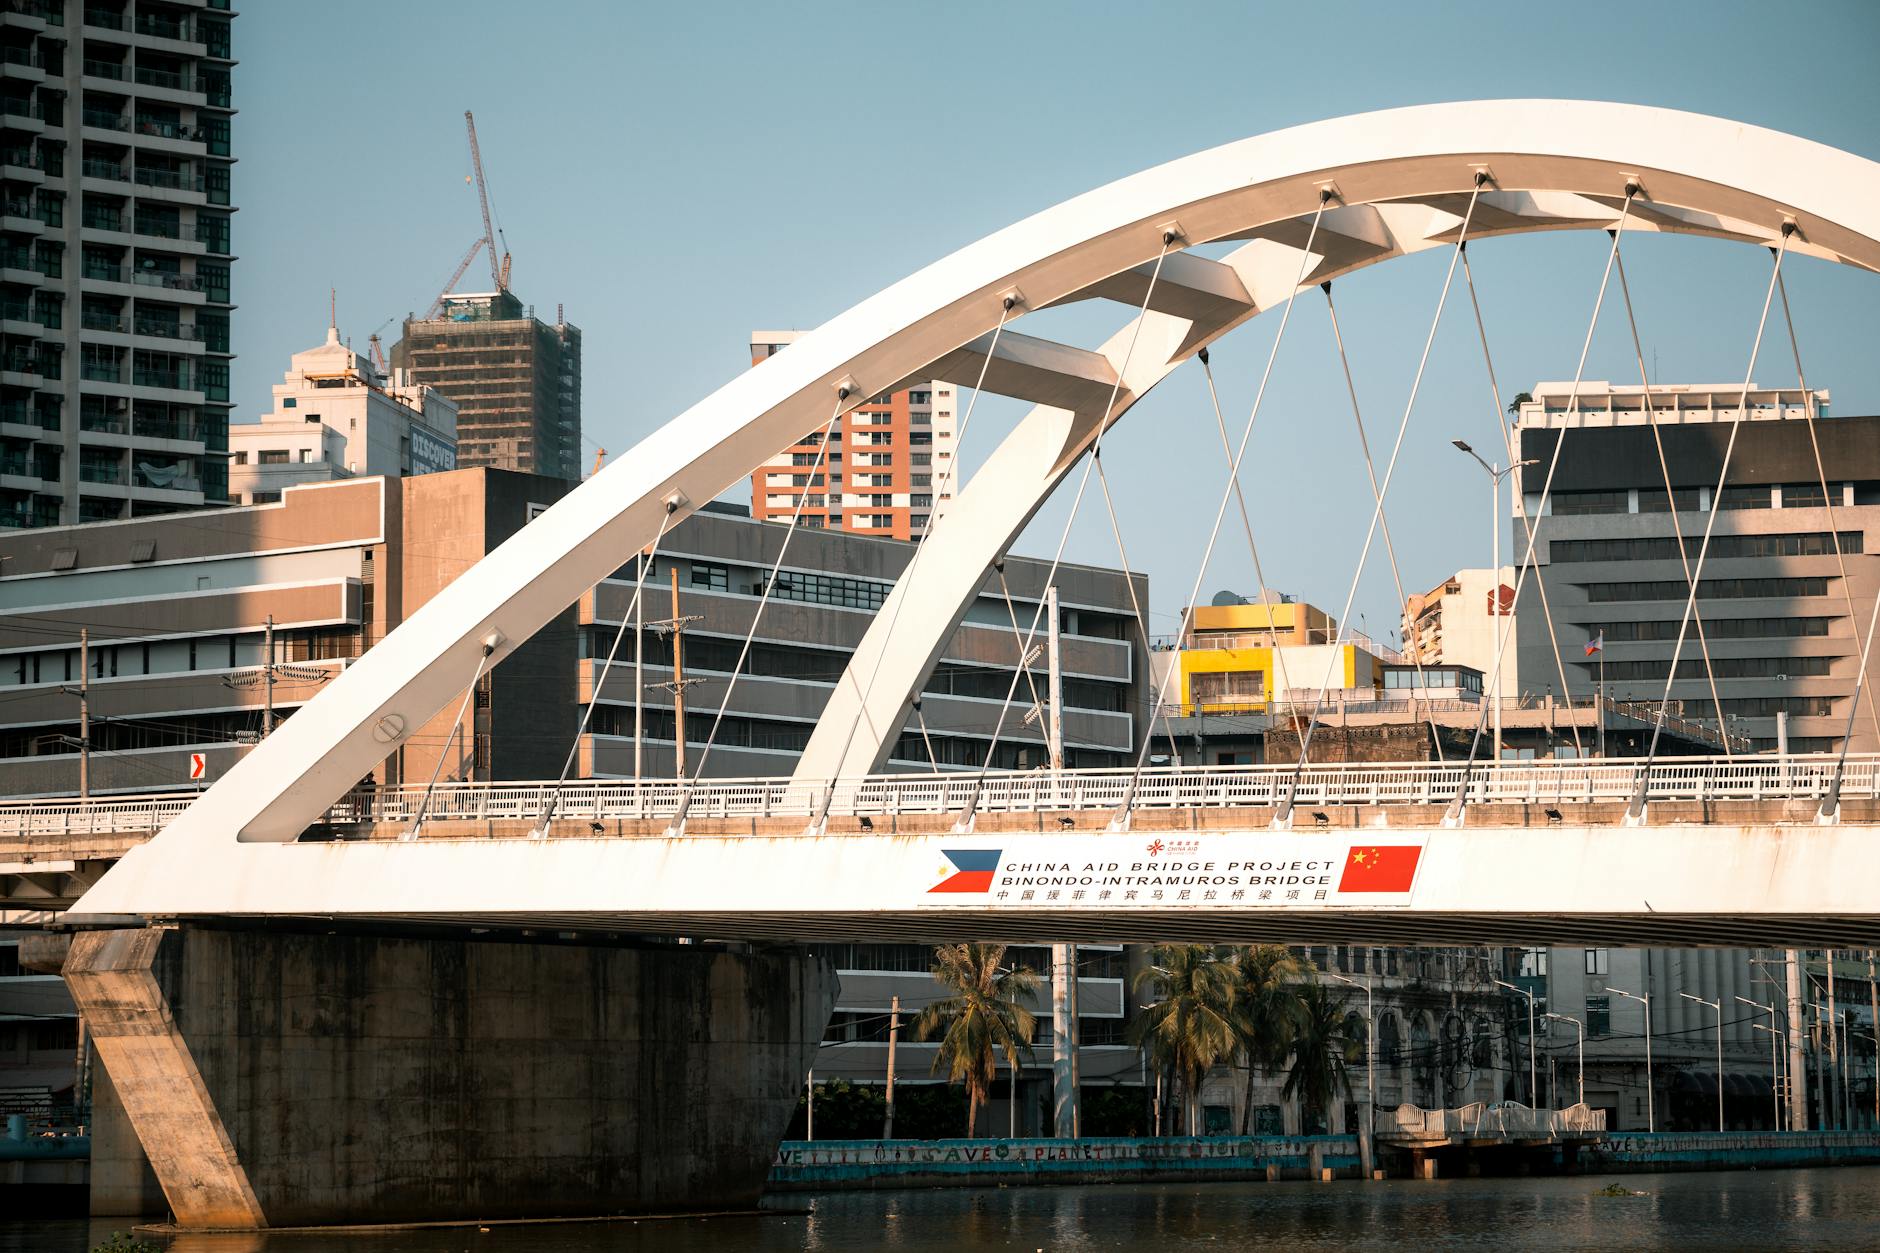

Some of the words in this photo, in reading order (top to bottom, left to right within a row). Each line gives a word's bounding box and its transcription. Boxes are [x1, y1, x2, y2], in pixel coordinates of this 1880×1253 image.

[412, 432, 456, 470] DISCOVER
[1006, 863, 1070, 872] CHINA
[1083, 862, 1119, 872] AID
[1130, 862, 1215, 872] BRIDGE
[1227, 861, 1334, 871] PROJECT
[1001, 876, 1240, 886] BINONDO-INTRAMUROS
[1249, 875, 1331, 885] BRIDGE
[997, 889, 1327, 901] 中国援菲律宾马尼拉桥梁项目
[1036, 1145, 1105, 1161] PLANET
